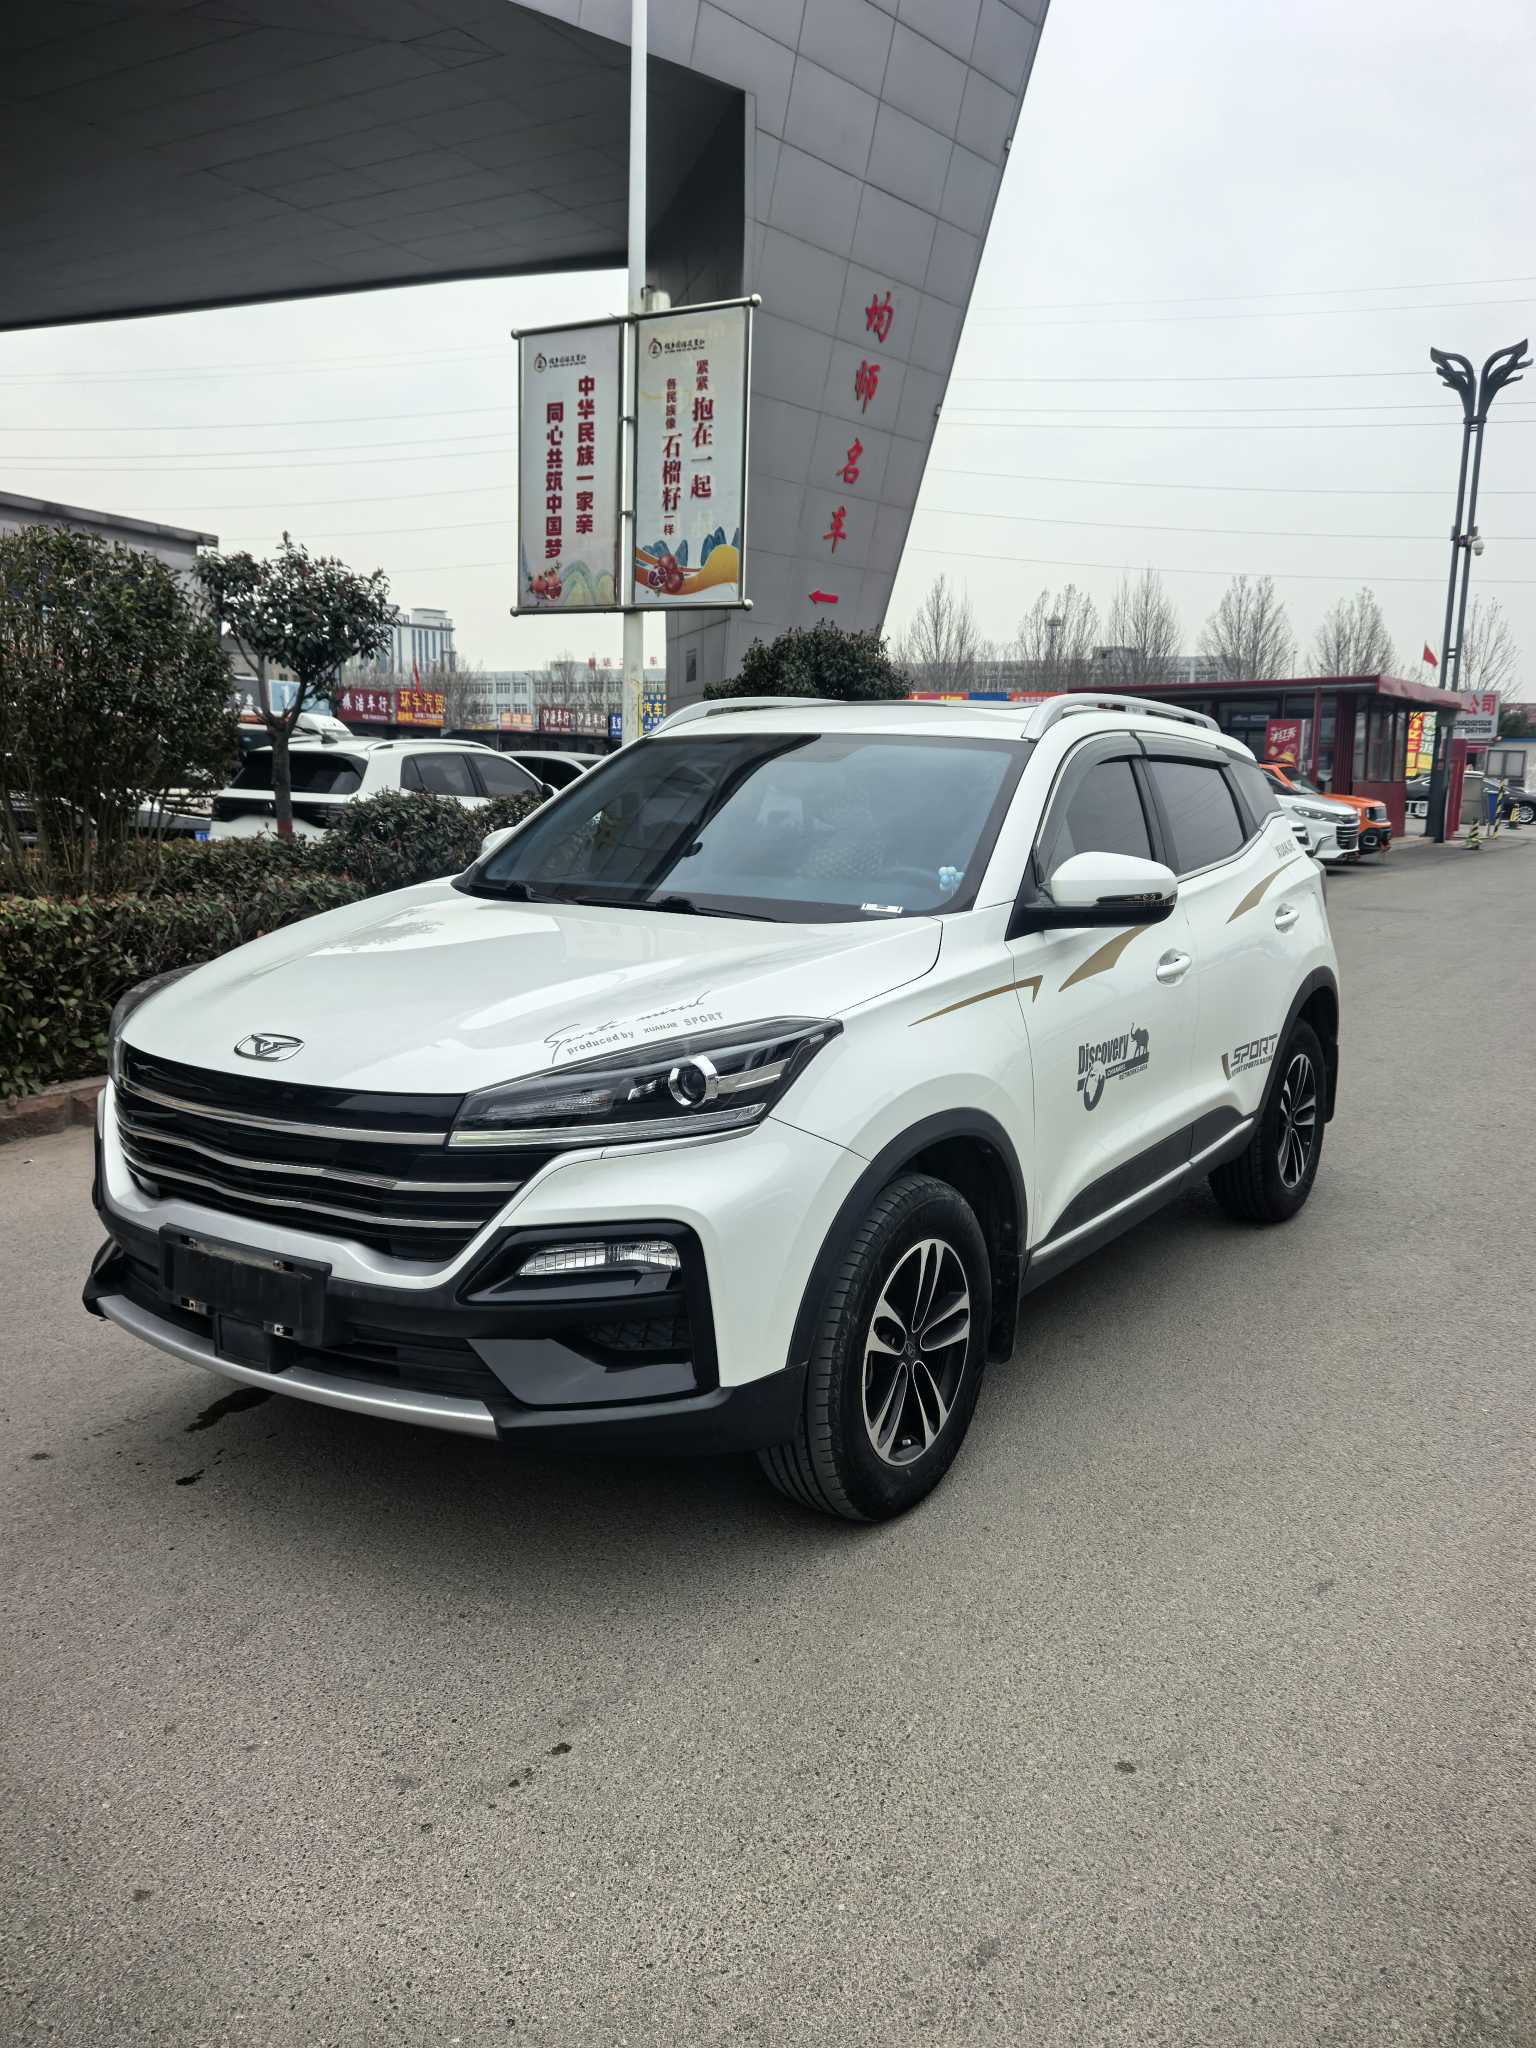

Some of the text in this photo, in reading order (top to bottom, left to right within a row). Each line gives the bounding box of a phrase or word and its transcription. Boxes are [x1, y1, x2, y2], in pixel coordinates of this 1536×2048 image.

[576, 376, 595, 534] 中华民族一家亲
[690, 359, 714, 499] 紧紧抱在一起
[545, 401, 564, 559] 同心共筑中国梦
[566, 1034, 620, 1055] produced
[622, 1030, 635, 1040] by
[684, 1012, 724, 1027] SPORT
[1078, 1034, 1129, 1074] Discovery
[1230, 1033, 1279, 1067] SPORT
